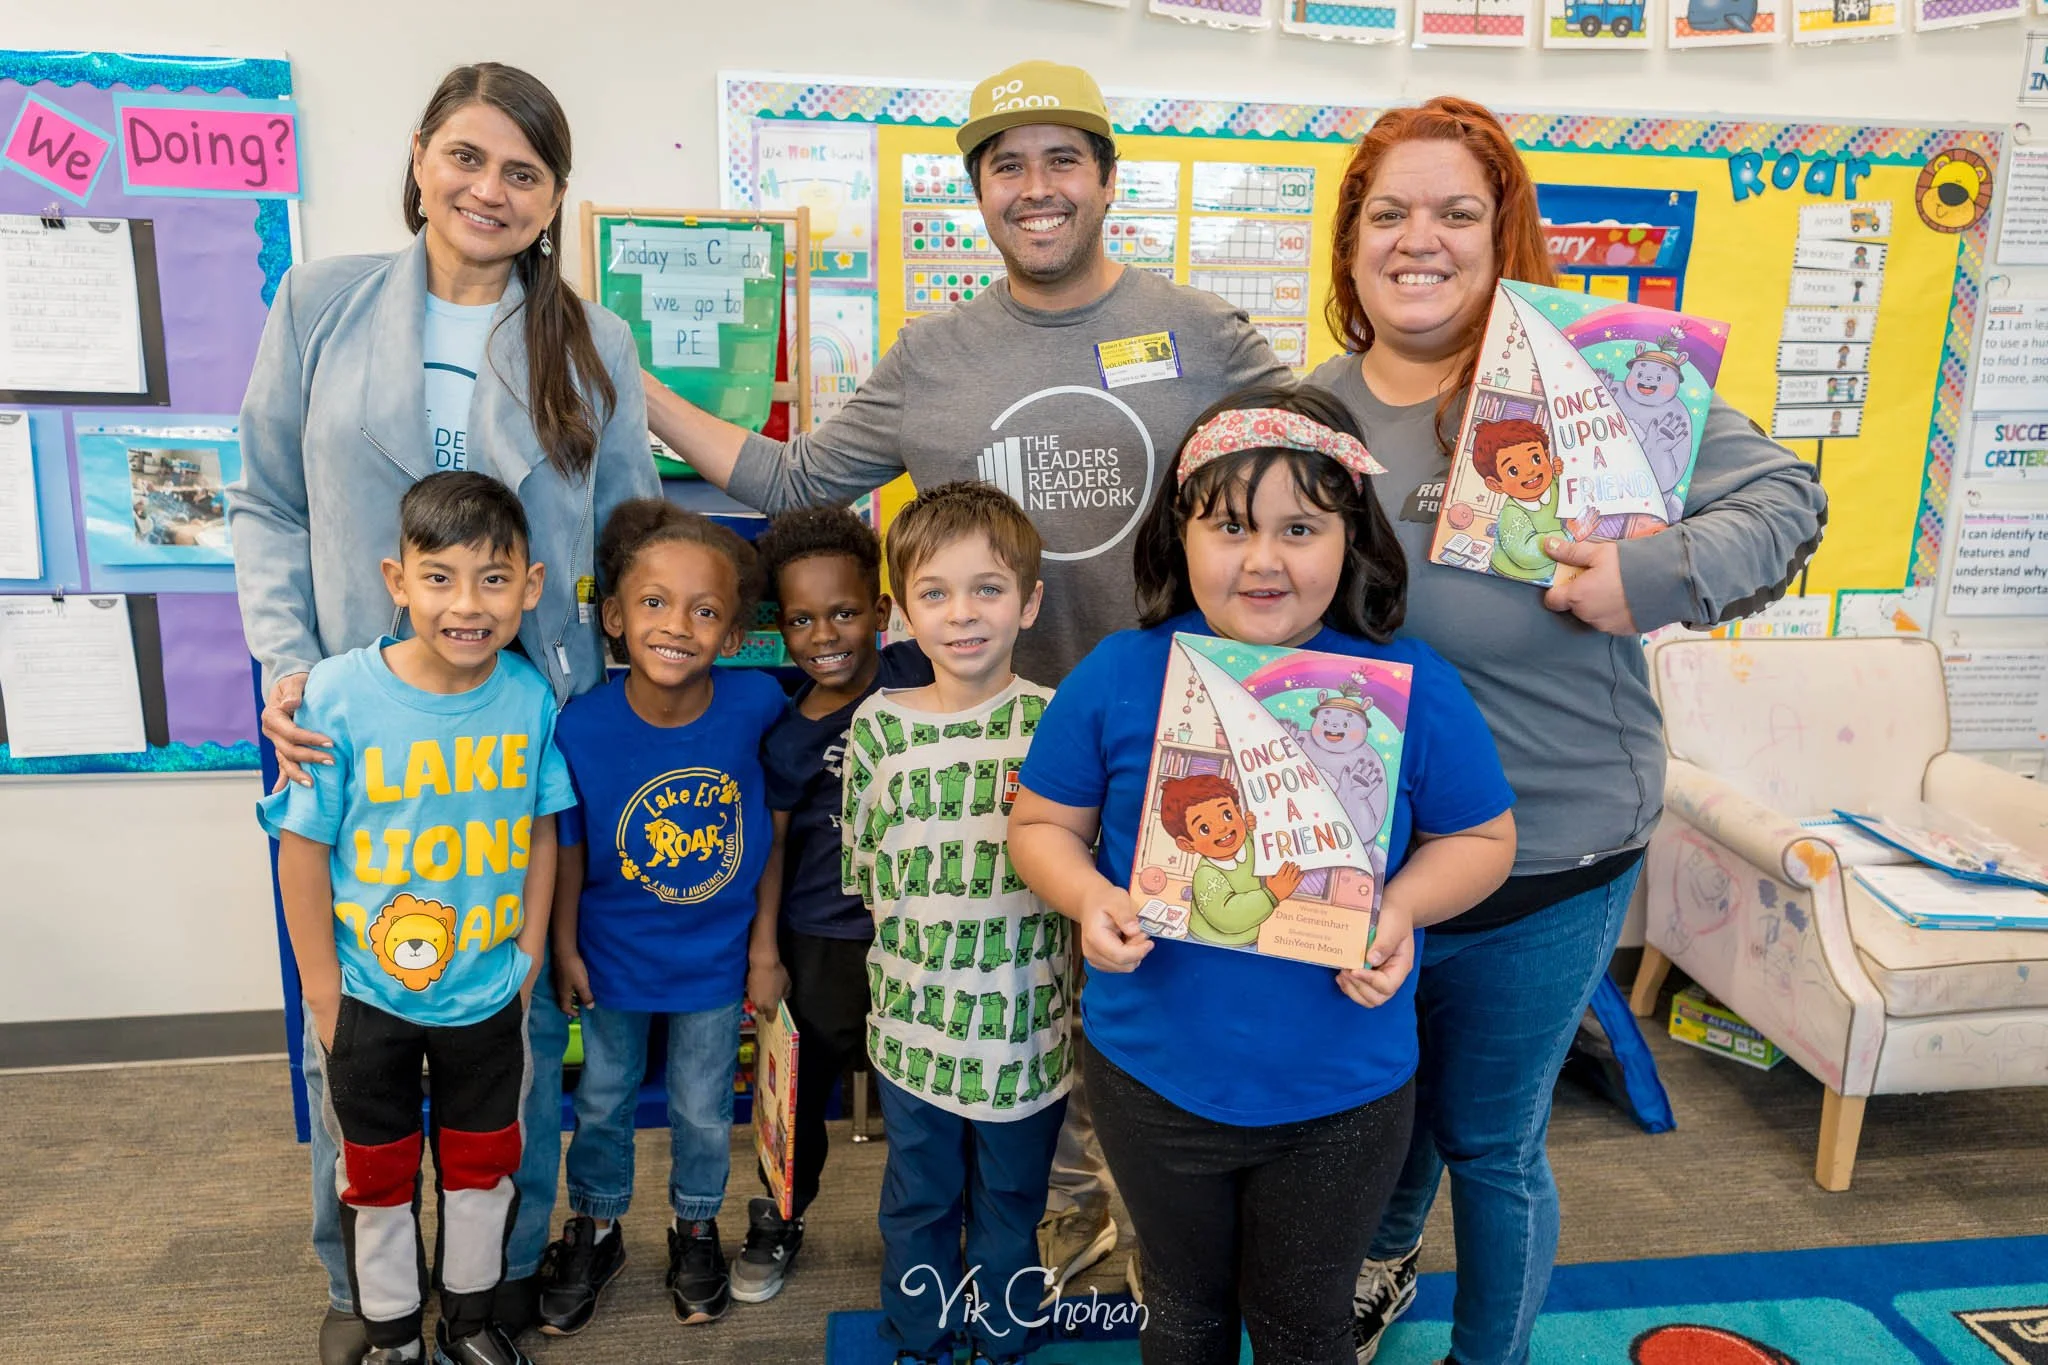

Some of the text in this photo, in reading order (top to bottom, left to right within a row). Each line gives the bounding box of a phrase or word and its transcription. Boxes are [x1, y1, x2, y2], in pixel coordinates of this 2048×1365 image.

[992, 80, 1023, 101] DO
[993, 95, 1060, 112] GOOD
[27, 116, 91, 181] We
[128, 117, 290, 188] Doing?
[788, 145, 826, 161] WORK
[1728, 152, 1871, 202] Roar
[1281, 184, 1306, 198] 130
[1279, 237, 1303, 250] 140
[616, 238, 669, 274] Today
[684, 248, 697, 266] is
[707, 239, 722, 265] C
[654, 288, 741, 321] we go to
[1275, 287, 1300, 301] 150
[1274, 338, 1297, 351] 160
[1105, 357, 1145, 369] VOLUNTEER
[811, 375, 856, 394] ISTEN
[1553, 385, 1610, 419] ONCE
[1559, 412, 1628, 449] UPON
[1023, 435, 1060, 451] THE
[1027, 448, 1119, 471] LEADERS
[1593, 446, 1608, 469] A
[1029, 468, 1121, 491] READERS
[1566, 470, 1653, 504] FRIEND
[1029, 487, 1135, 511] NETWORK
[1418, 500, 1442, 513] FO
[1961, 529, 1966, 539] I
[1968, 531, 1988, 539] can
[1990, 528, 2036, 541] identify
[1958, 546, 2031, 558] features and
[1955, 565, 2048, 578] understand why
[1952, 584, 1978, 597] they
[1981, 586, 2000, 595] are
[1240, 735, 1298, 772] ONCE
[365, 734, 529, 804] LAKE
[1248, 761, 1320, 803] UPON
[643, 782, 720, 818] Lake ES
[1287, 798, 1302, 823] A
[354, 814, 532, 885] LIONS
[656, 824, 725, 860] ROAR
[1261, 821, 1353, 861] FRIEND
[1275, 910, 1349, 931] Dan Gemeinhart
[1274, 935, 1343, 957] ShinYeon Moon
